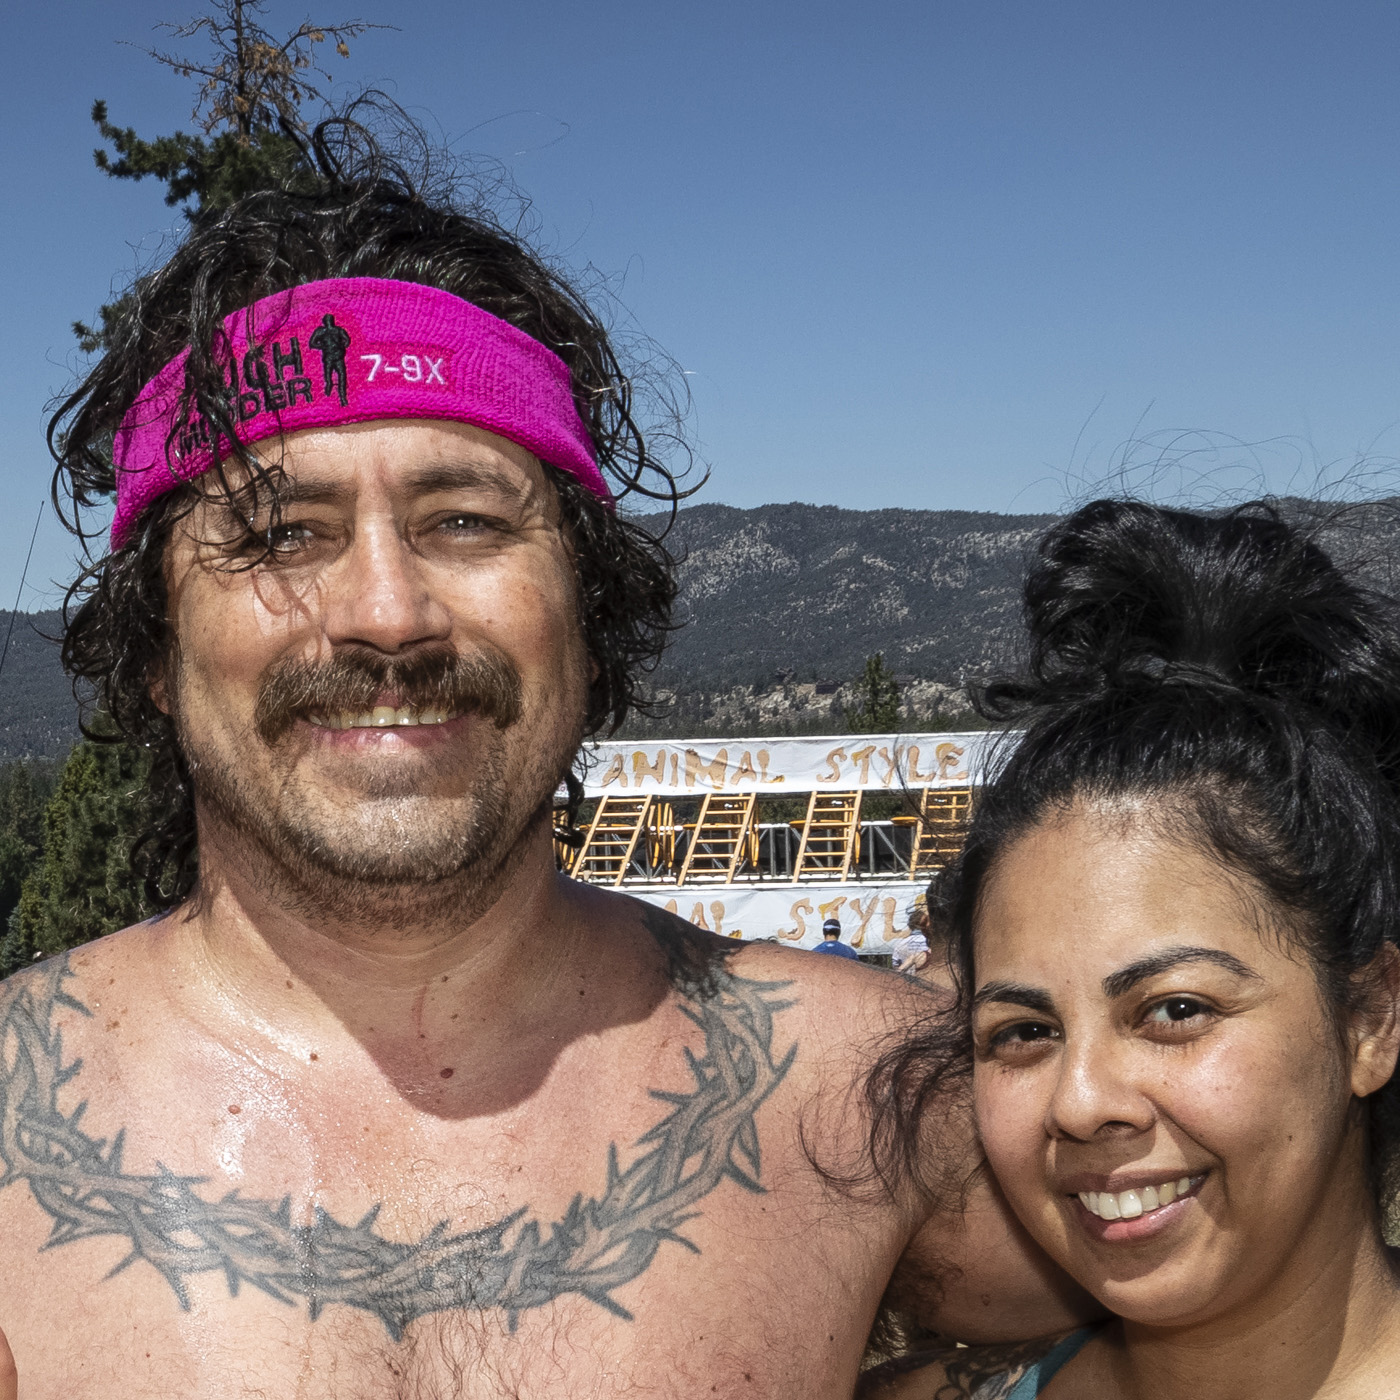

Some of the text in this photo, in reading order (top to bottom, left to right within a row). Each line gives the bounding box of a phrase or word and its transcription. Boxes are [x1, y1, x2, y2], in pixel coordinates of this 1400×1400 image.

[360, 353, 446, 384] 7-9X
[602, 742, 969, 790] ANIMAL STYLE
